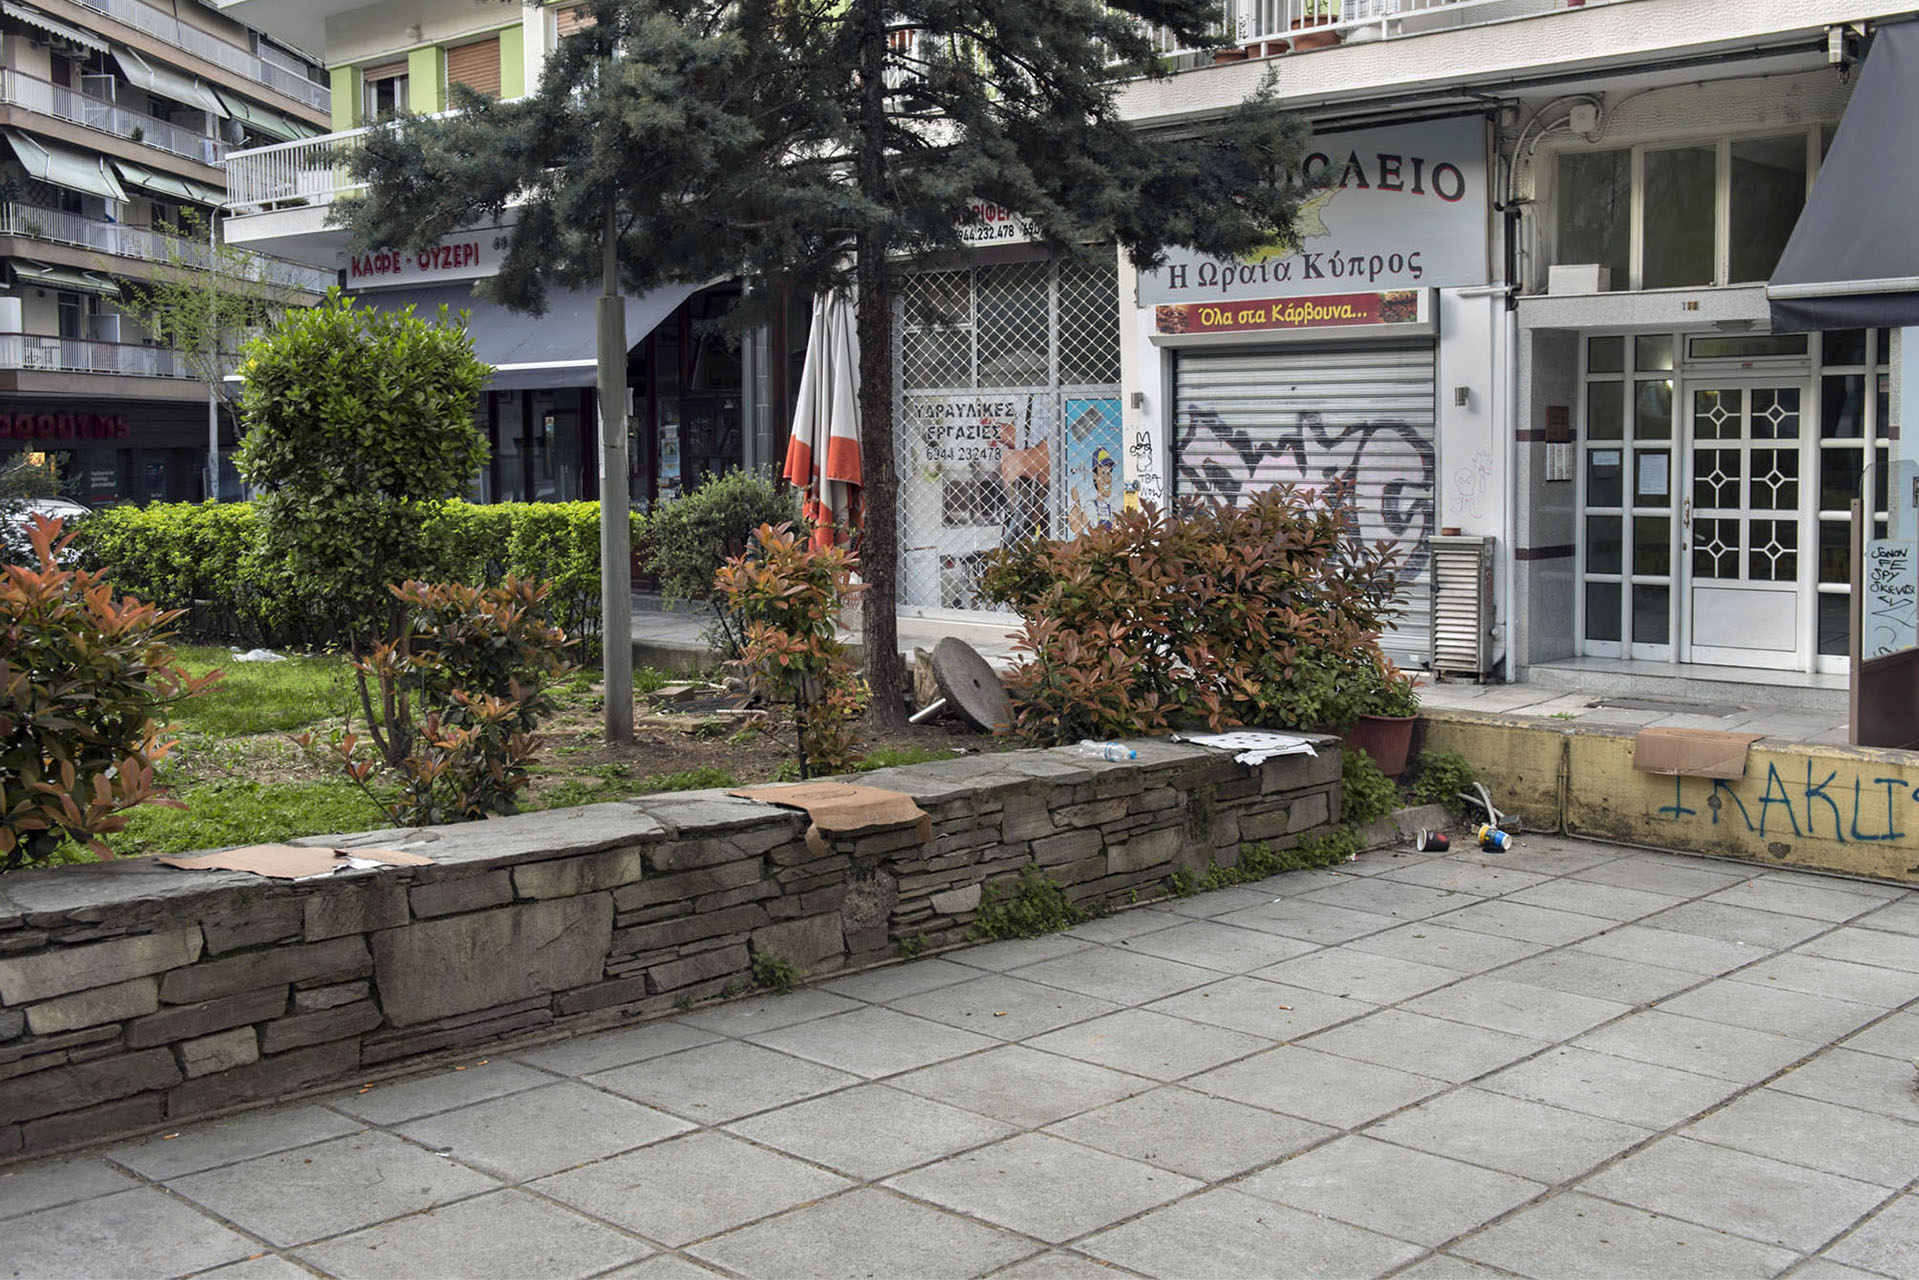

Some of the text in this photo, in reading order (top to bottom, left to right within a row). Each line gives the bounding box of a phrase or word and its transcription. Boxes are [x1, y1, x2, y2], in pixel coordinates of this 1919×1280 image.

[959, 224, 1015, 241] 944.232.478
[351, 250, 401, 278] ΚΑΦΕ
[417, 242, 480, 271] ΟΥΖΕΡΙ
[1168, 250, 1423, 292] Η Ωραία Κύπρος
[1198, 302, 1368, 326] Όλα στα Κάρβουνα...
[927, 425, 1002, 440] ΕΡΓΑΣΙΕΣ
[926, 447, 1002, 461] 6944 232478
